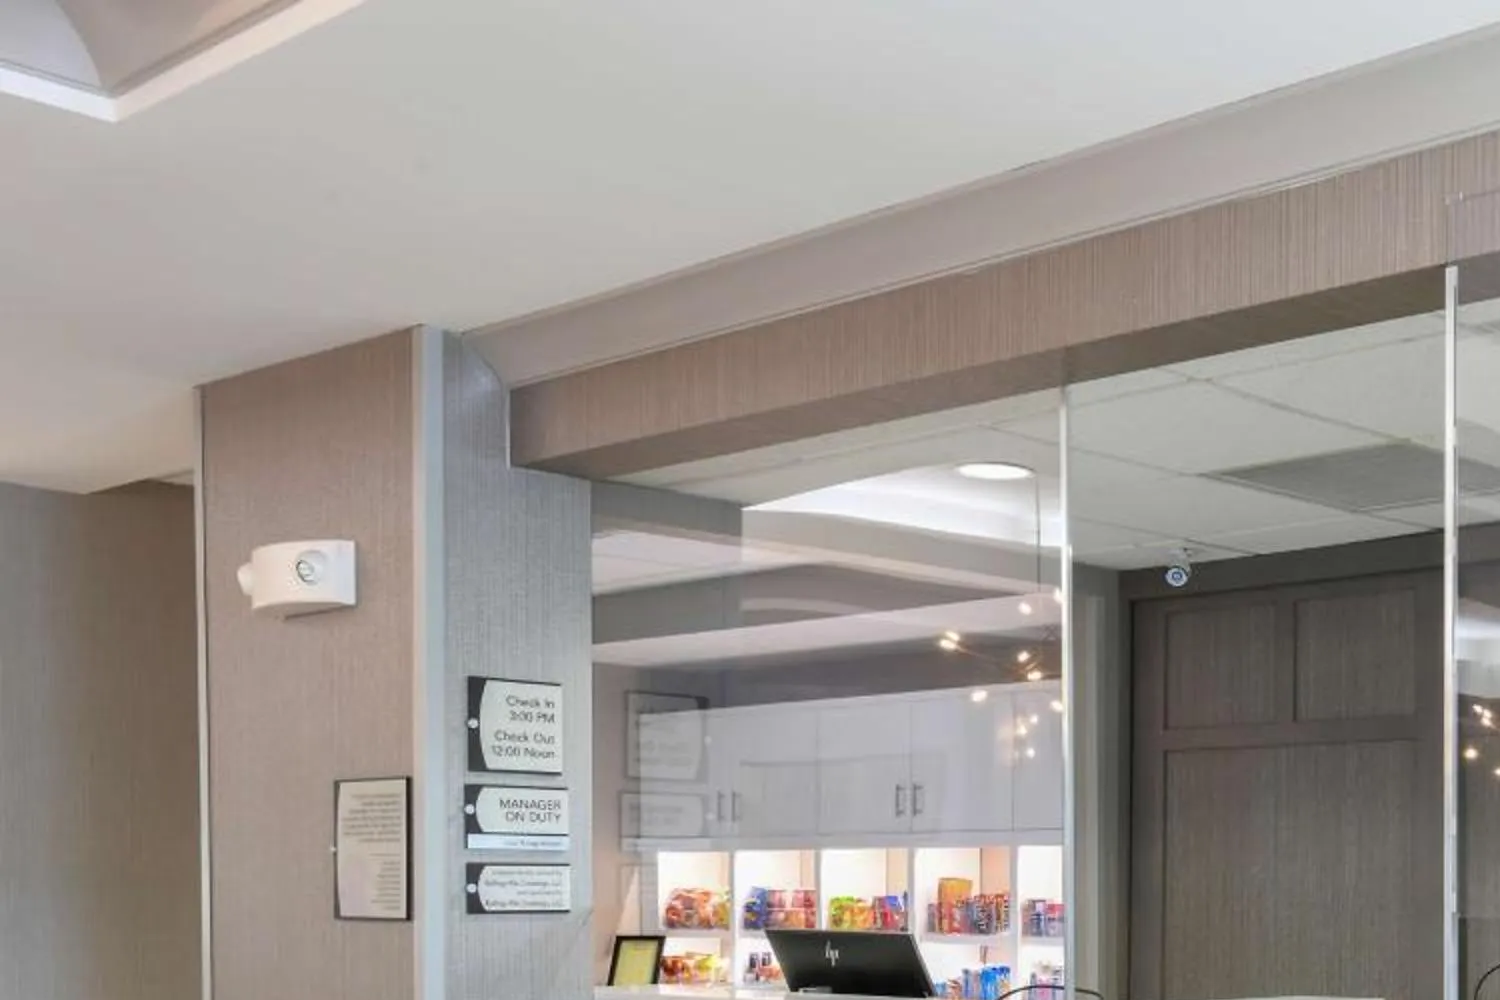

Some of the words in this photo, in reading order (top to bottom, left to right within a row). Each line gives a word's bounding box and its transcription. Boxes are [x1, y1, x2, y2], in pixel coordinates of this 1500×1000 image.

[499, 799, 561, 810] MANAGER
[505, 811, 524, 822] ON
[529, 811, 561, 824] DUTY
